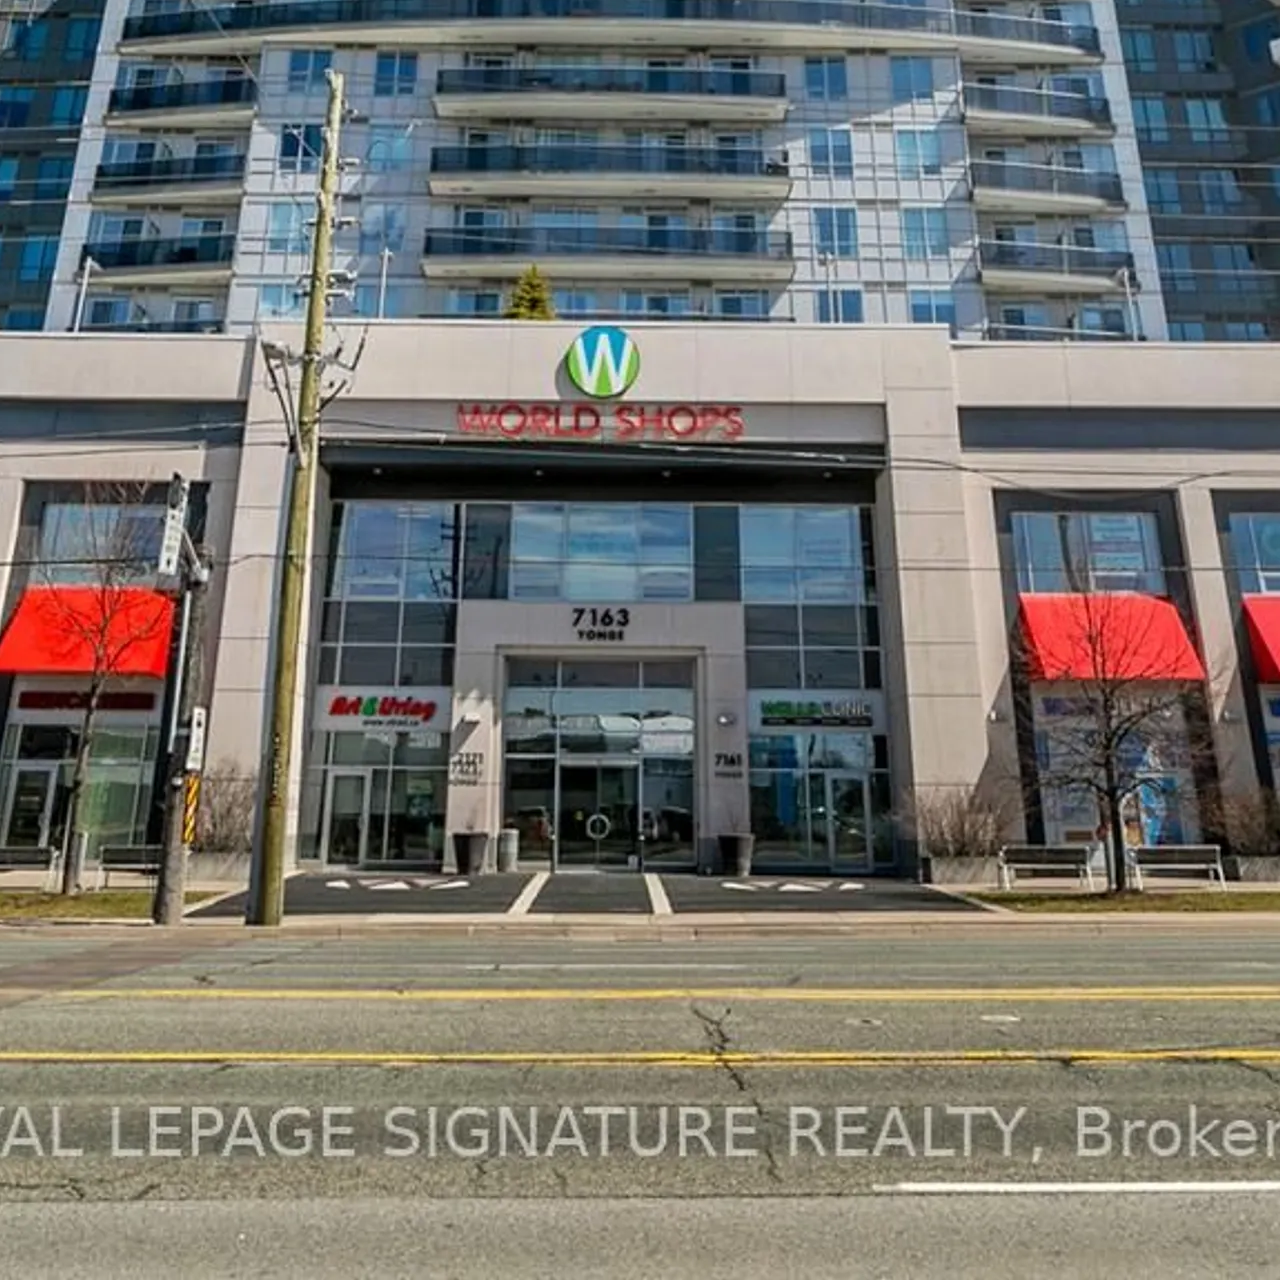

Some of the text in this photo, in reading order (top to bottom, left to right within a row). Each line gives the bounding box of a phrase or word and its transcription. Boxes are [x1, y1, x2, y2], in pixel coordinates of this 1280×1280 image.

[456, 402, 744, 438] WORLD SHOPS
[572, 607, 630, 628] 7163
